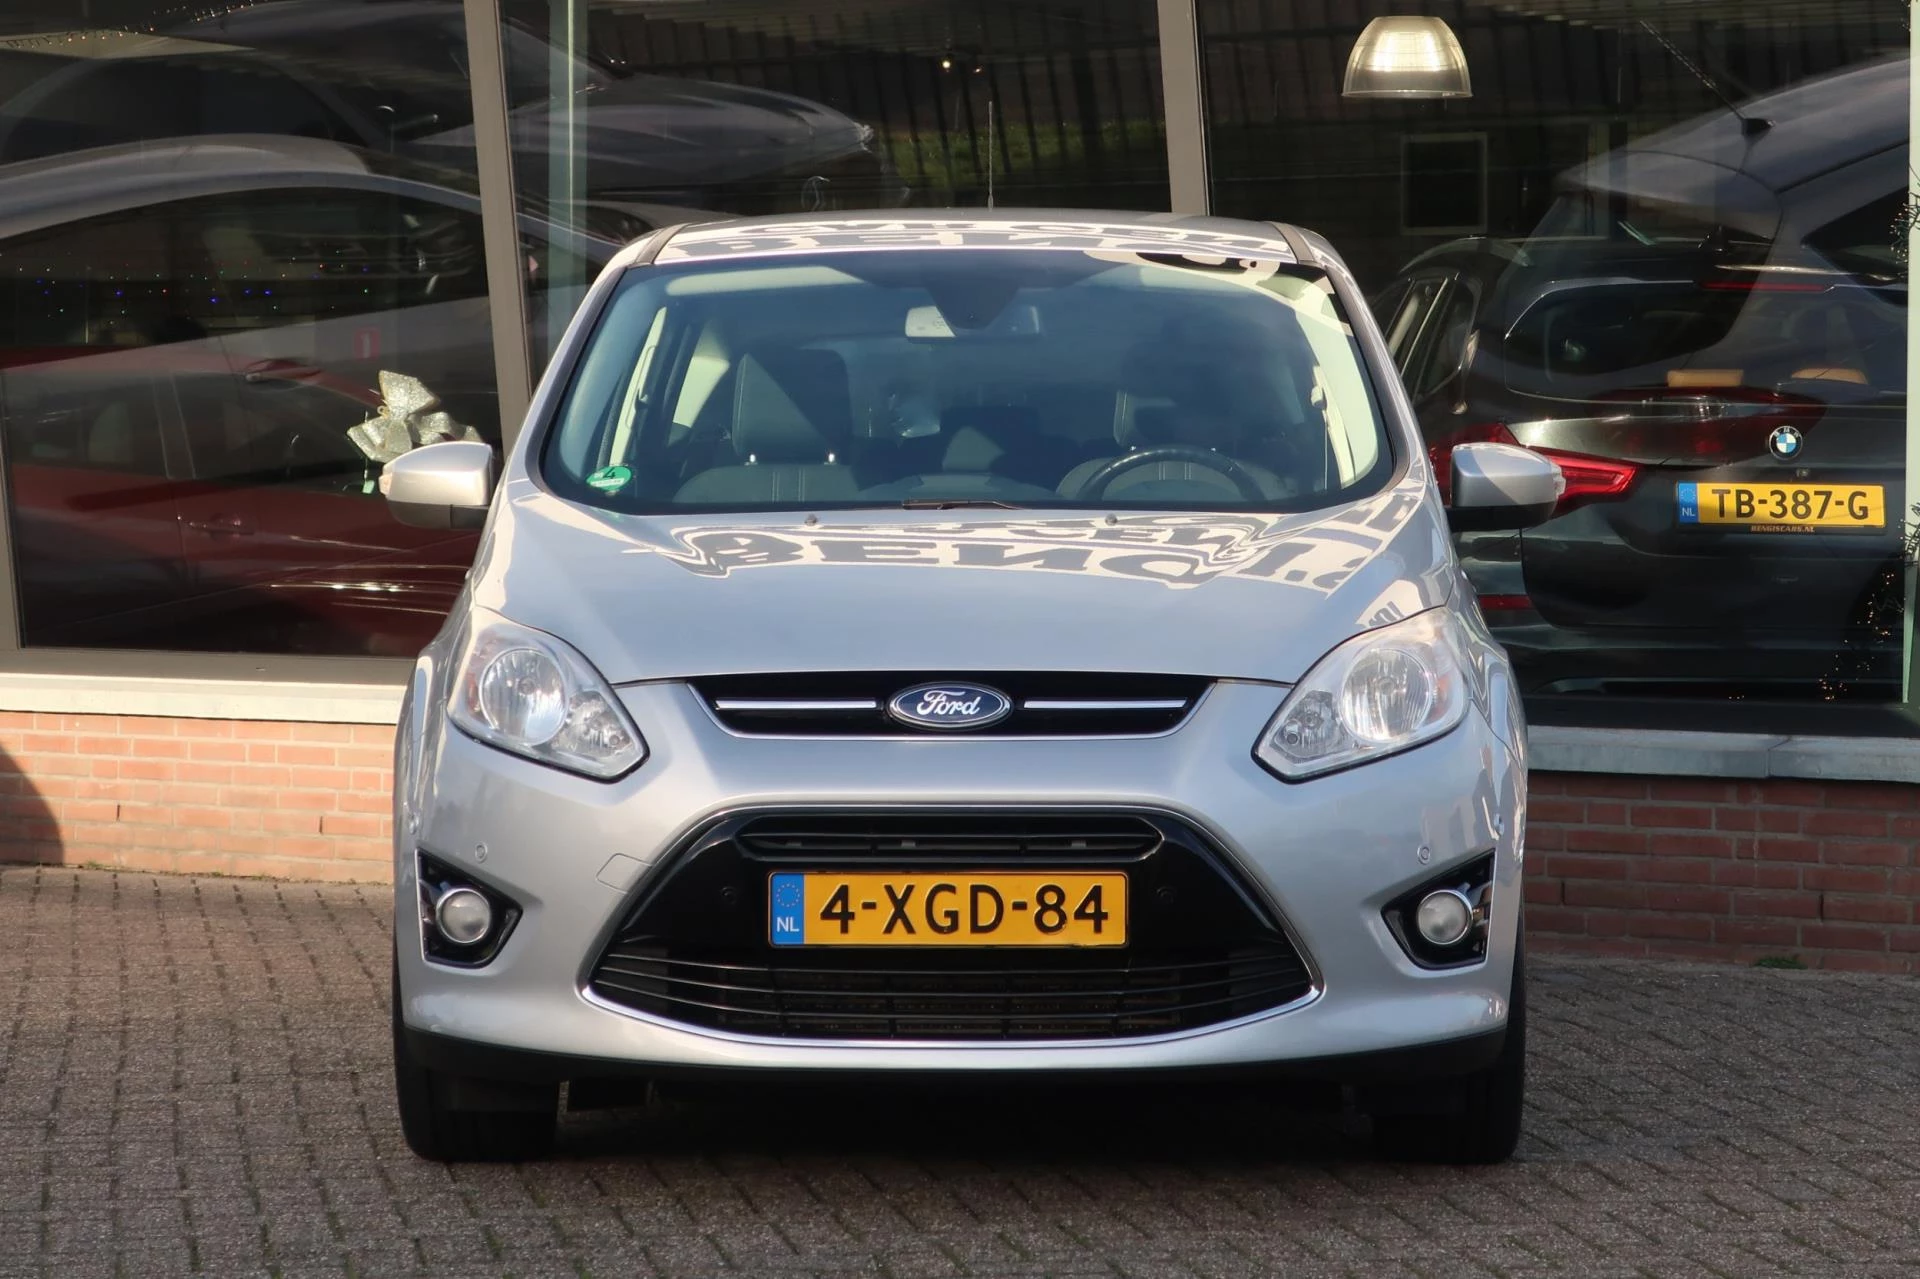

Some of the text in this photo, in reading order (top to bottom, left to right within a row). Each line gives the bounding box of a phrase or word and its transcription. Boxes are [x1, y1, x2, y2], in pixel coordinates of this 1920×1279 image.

[1682, 488, 1869, 520] NL TB-387-G
[916, 690, 981, 715] Ford
[776, 883, 1109, 935] NL 4-XGD-84
